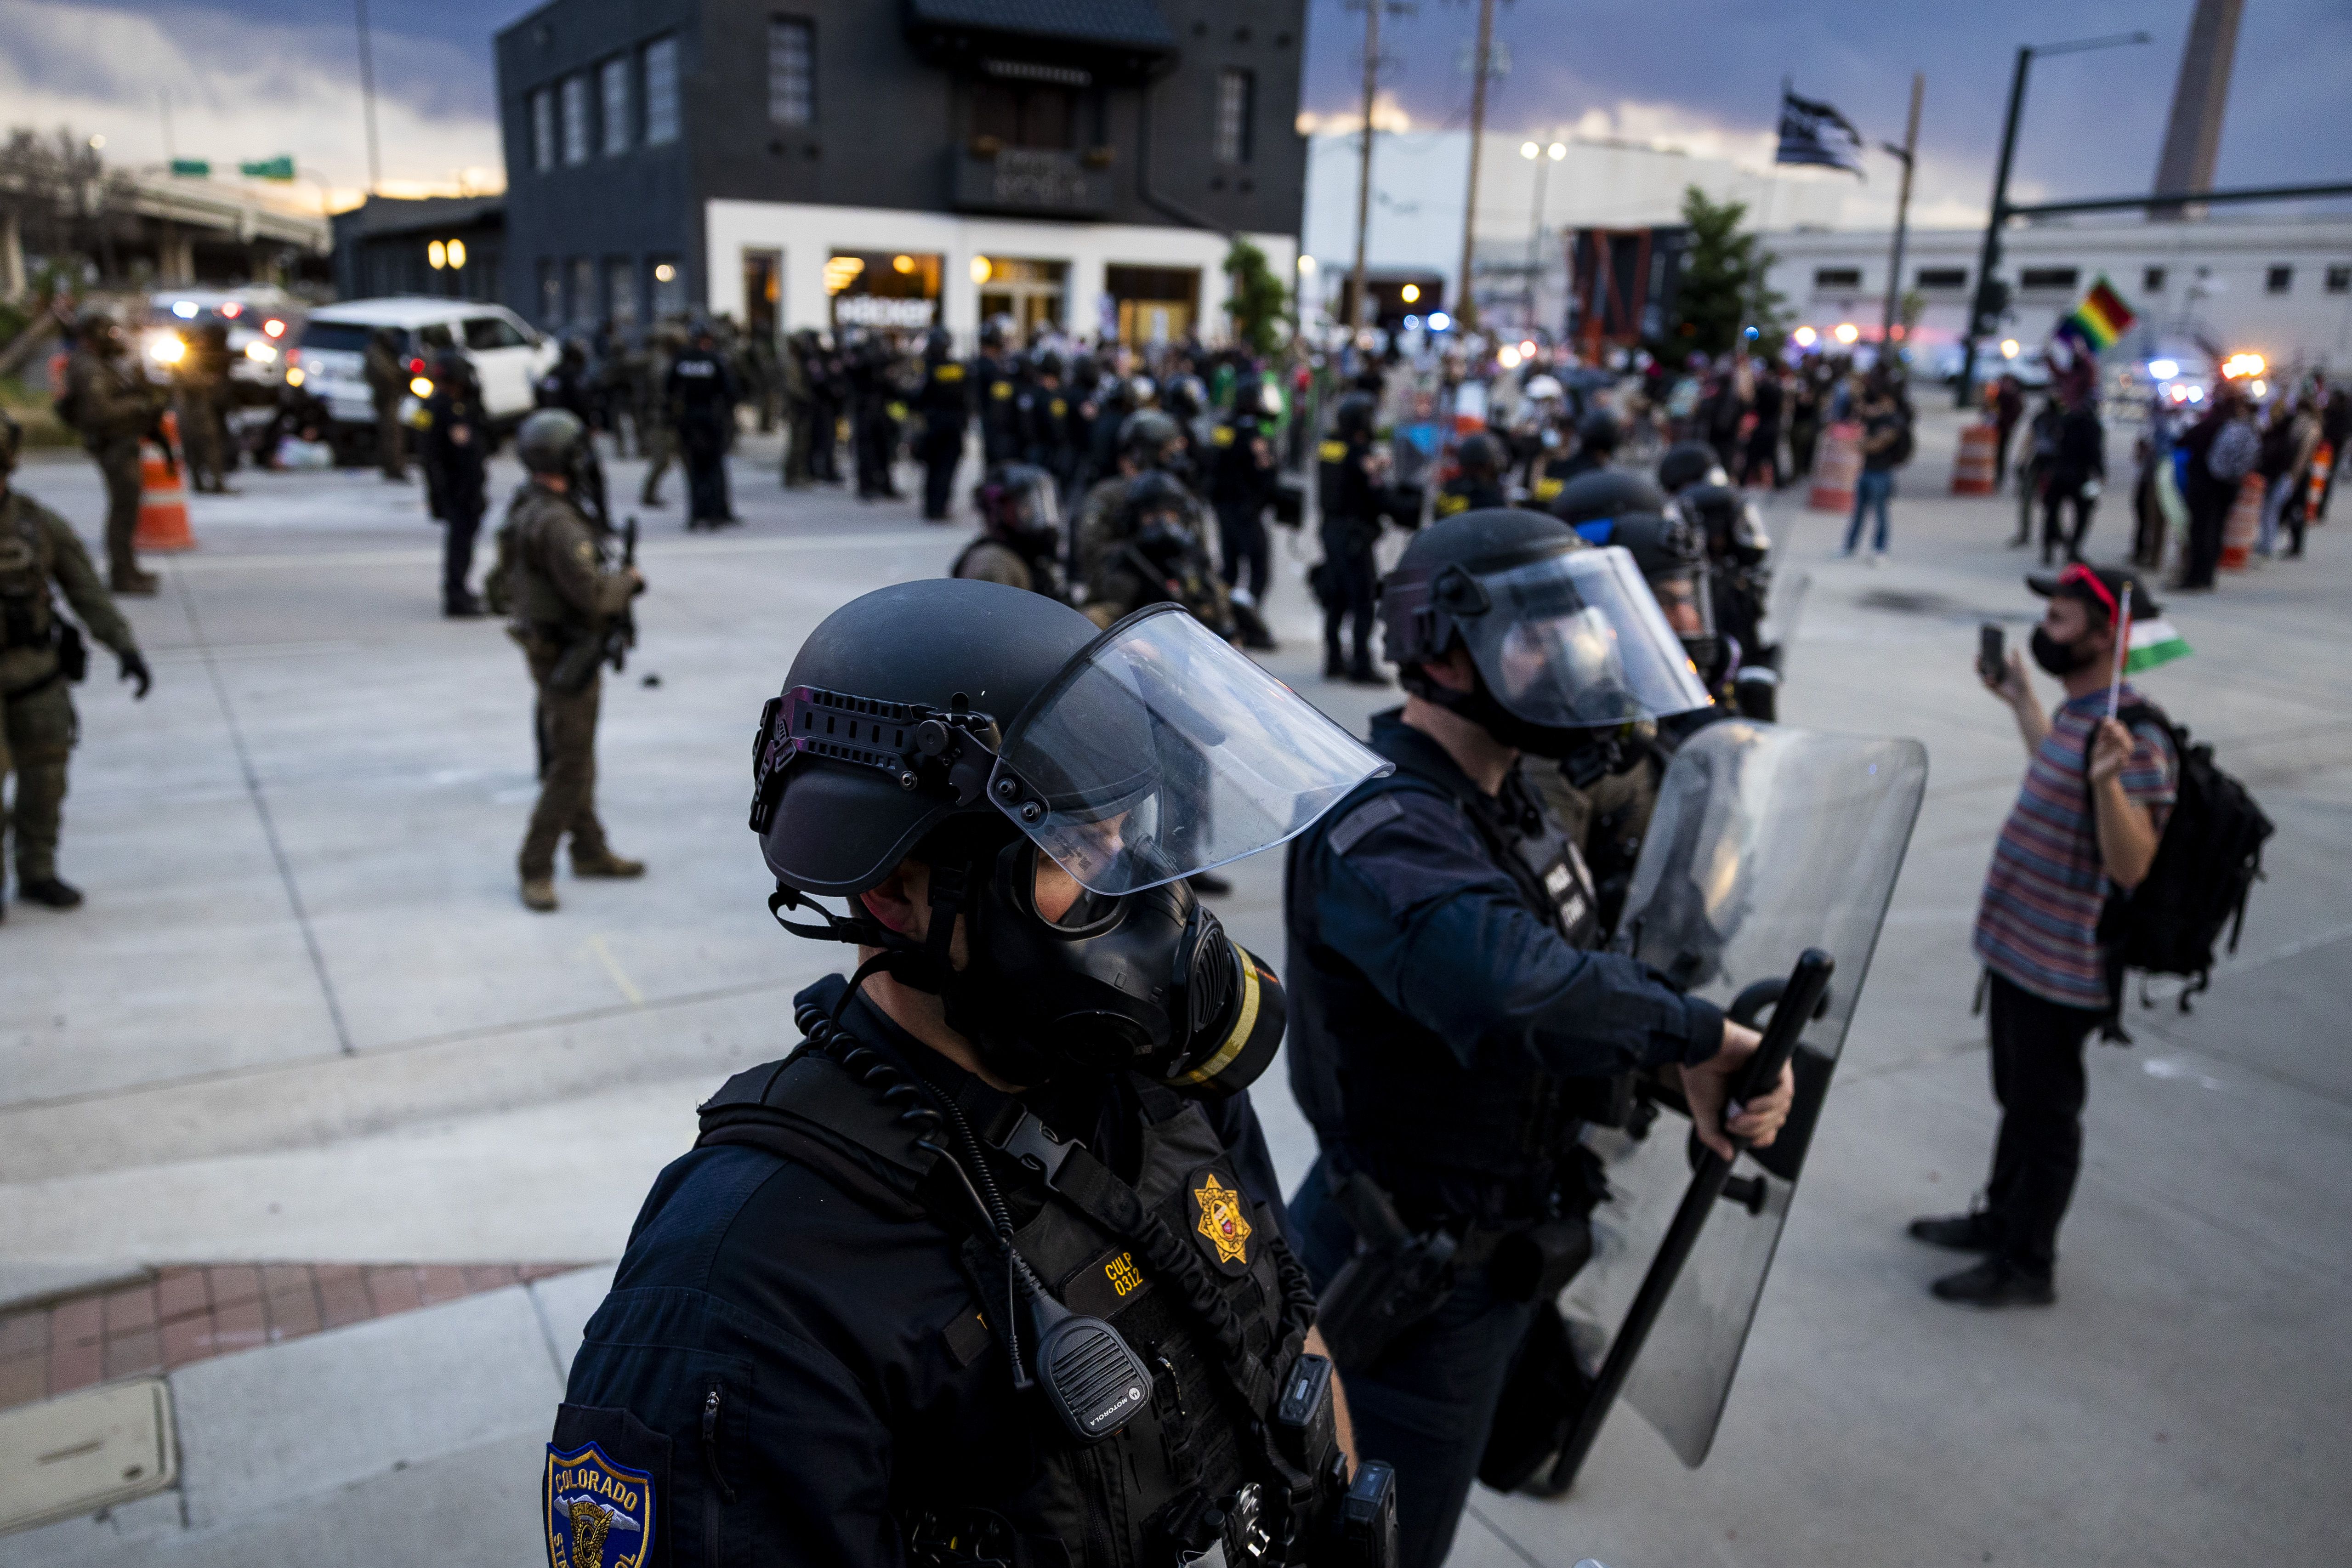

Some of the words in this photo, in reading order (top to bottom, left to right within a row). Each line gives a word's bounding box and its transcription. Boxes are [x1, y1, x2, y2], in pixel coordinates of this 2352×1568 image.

[1105, 1252, 1132, 1280] CULP
[1115, 1267, 1143, 1295] 0312
[1090, 1398, 1128, 1426] MOTOROLA
[556, 1469, 637, 1511] COLORADO
